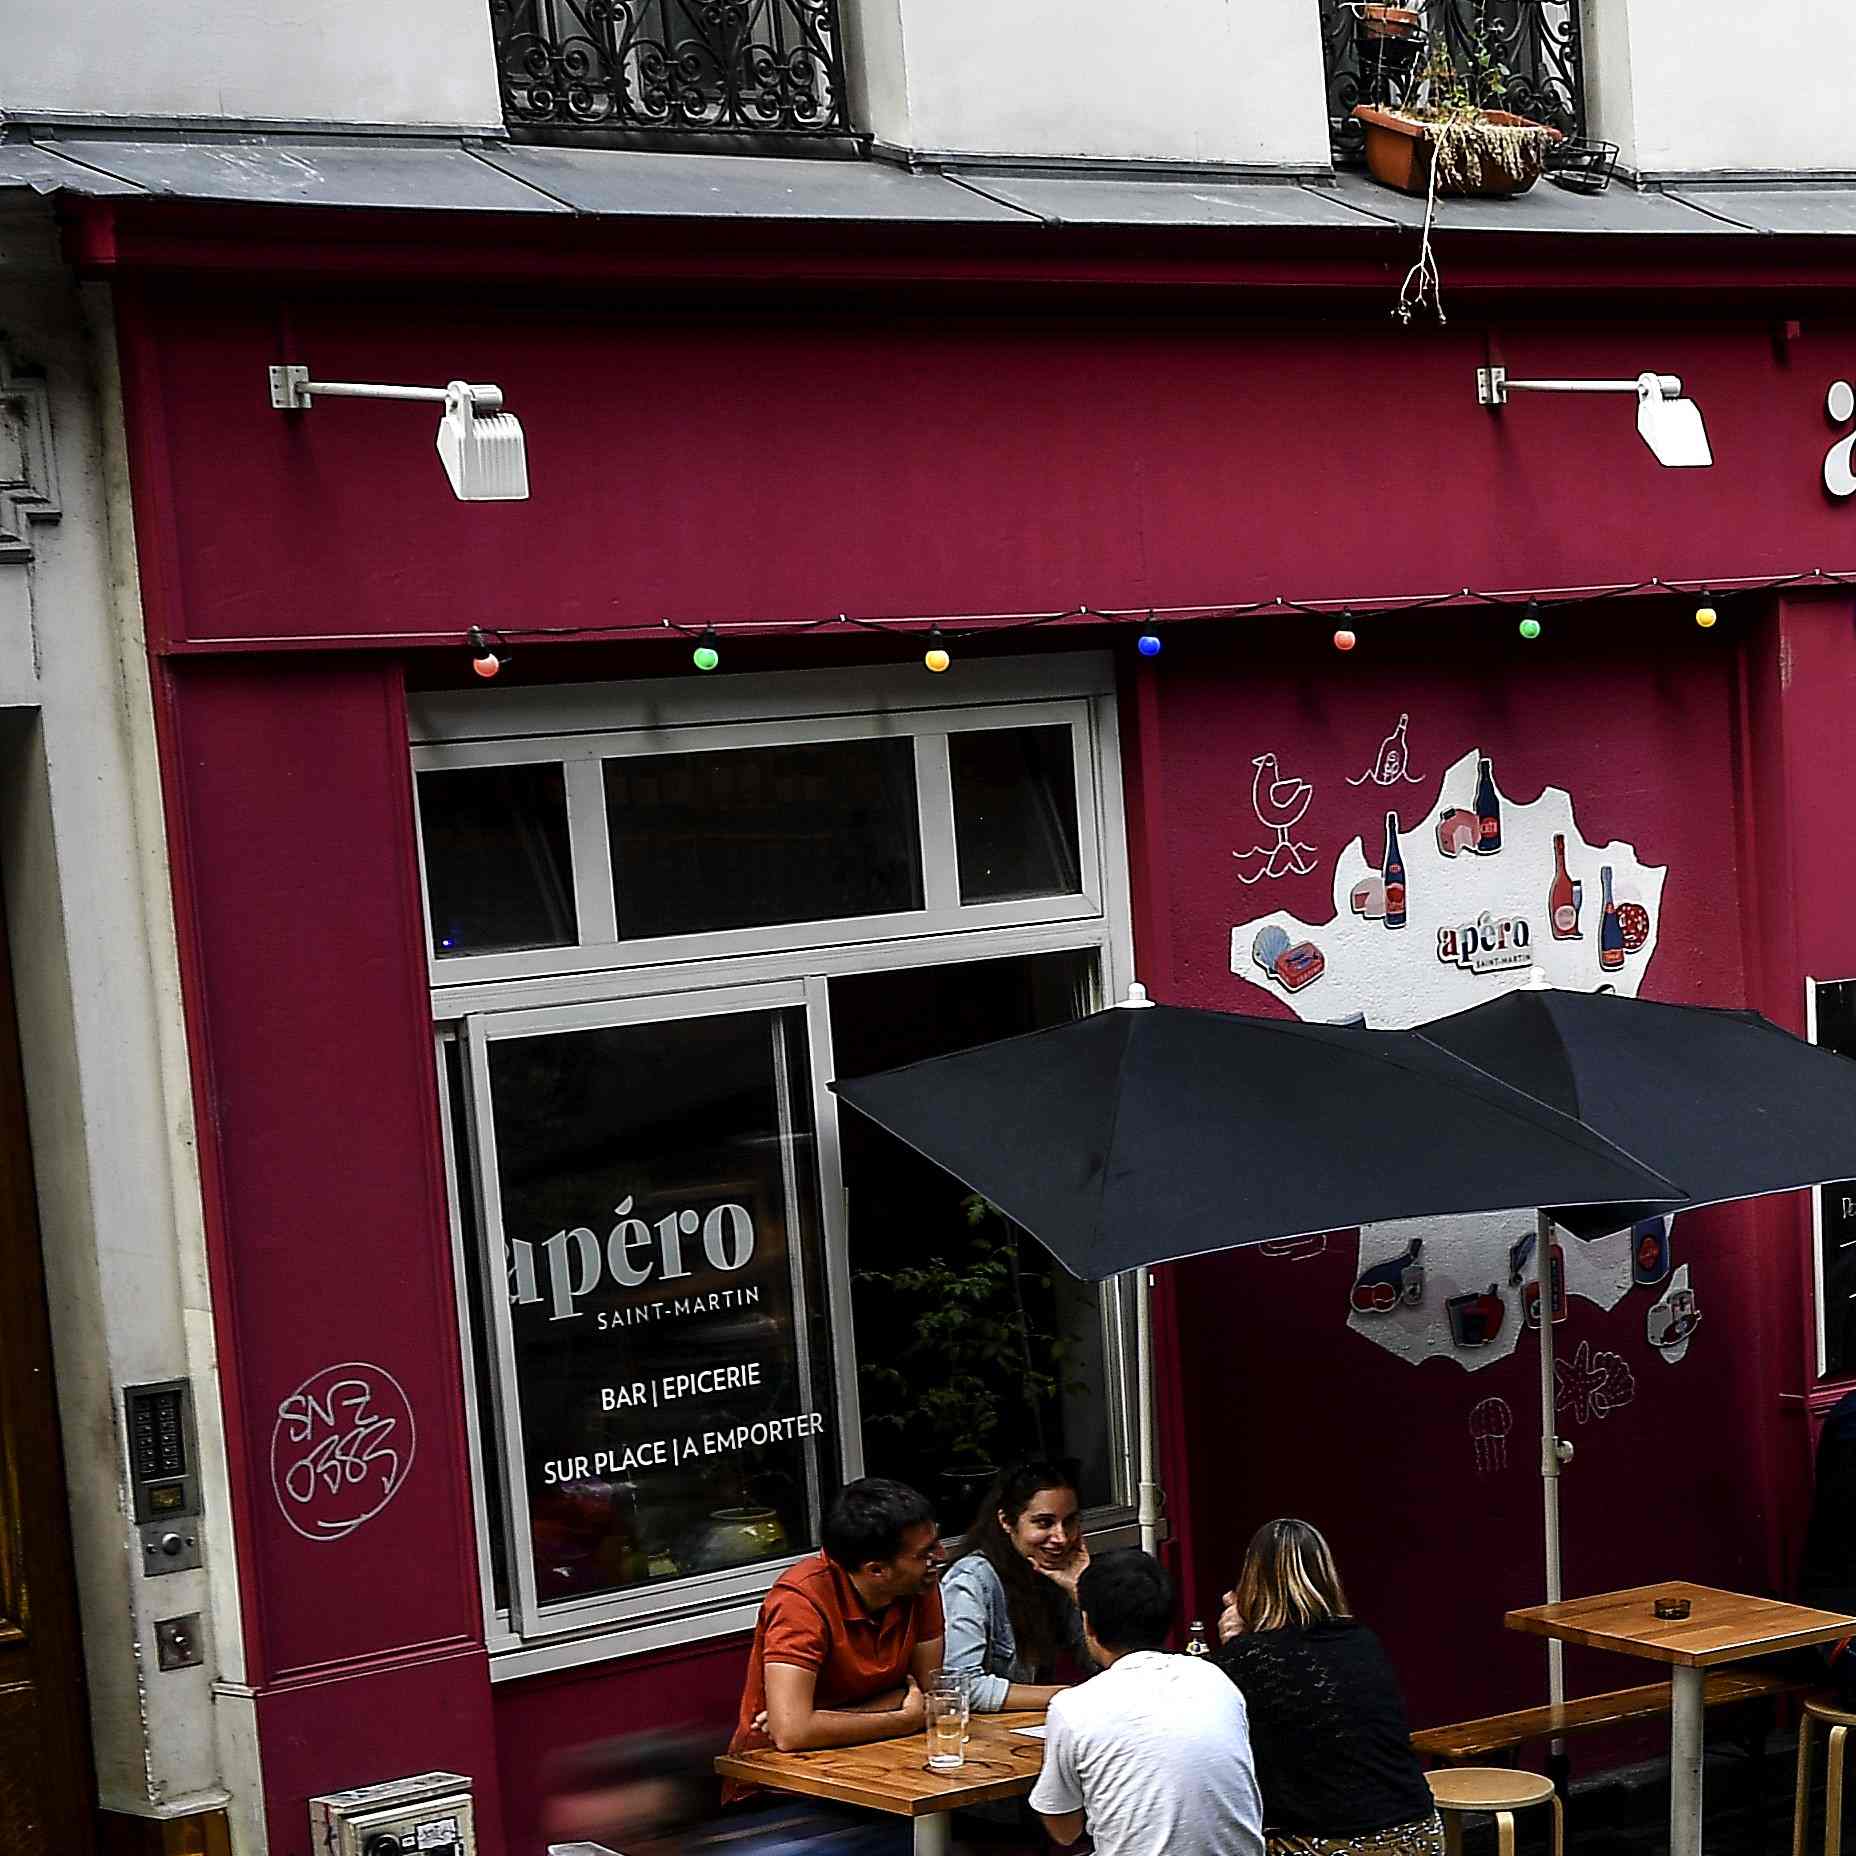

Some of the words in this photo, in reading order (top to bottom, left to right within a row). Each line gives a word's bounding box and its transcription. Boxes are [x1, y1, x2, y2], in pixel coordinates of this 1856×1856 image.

[1442, 915, 1529, 963] apéro
[598, 1286, 760, 1330] SAINT-MARTIN
[601, 1381, 647, 1411] BAR
[663, 1363, 761, 1400] EPICERIE
[544, 1456, 592, 1484] SUR
[594, 1440, 668, 1476] PLACE
[682, 1436, 699, 1460] A
[703, 1412, 824, 1456] EMPORTER
